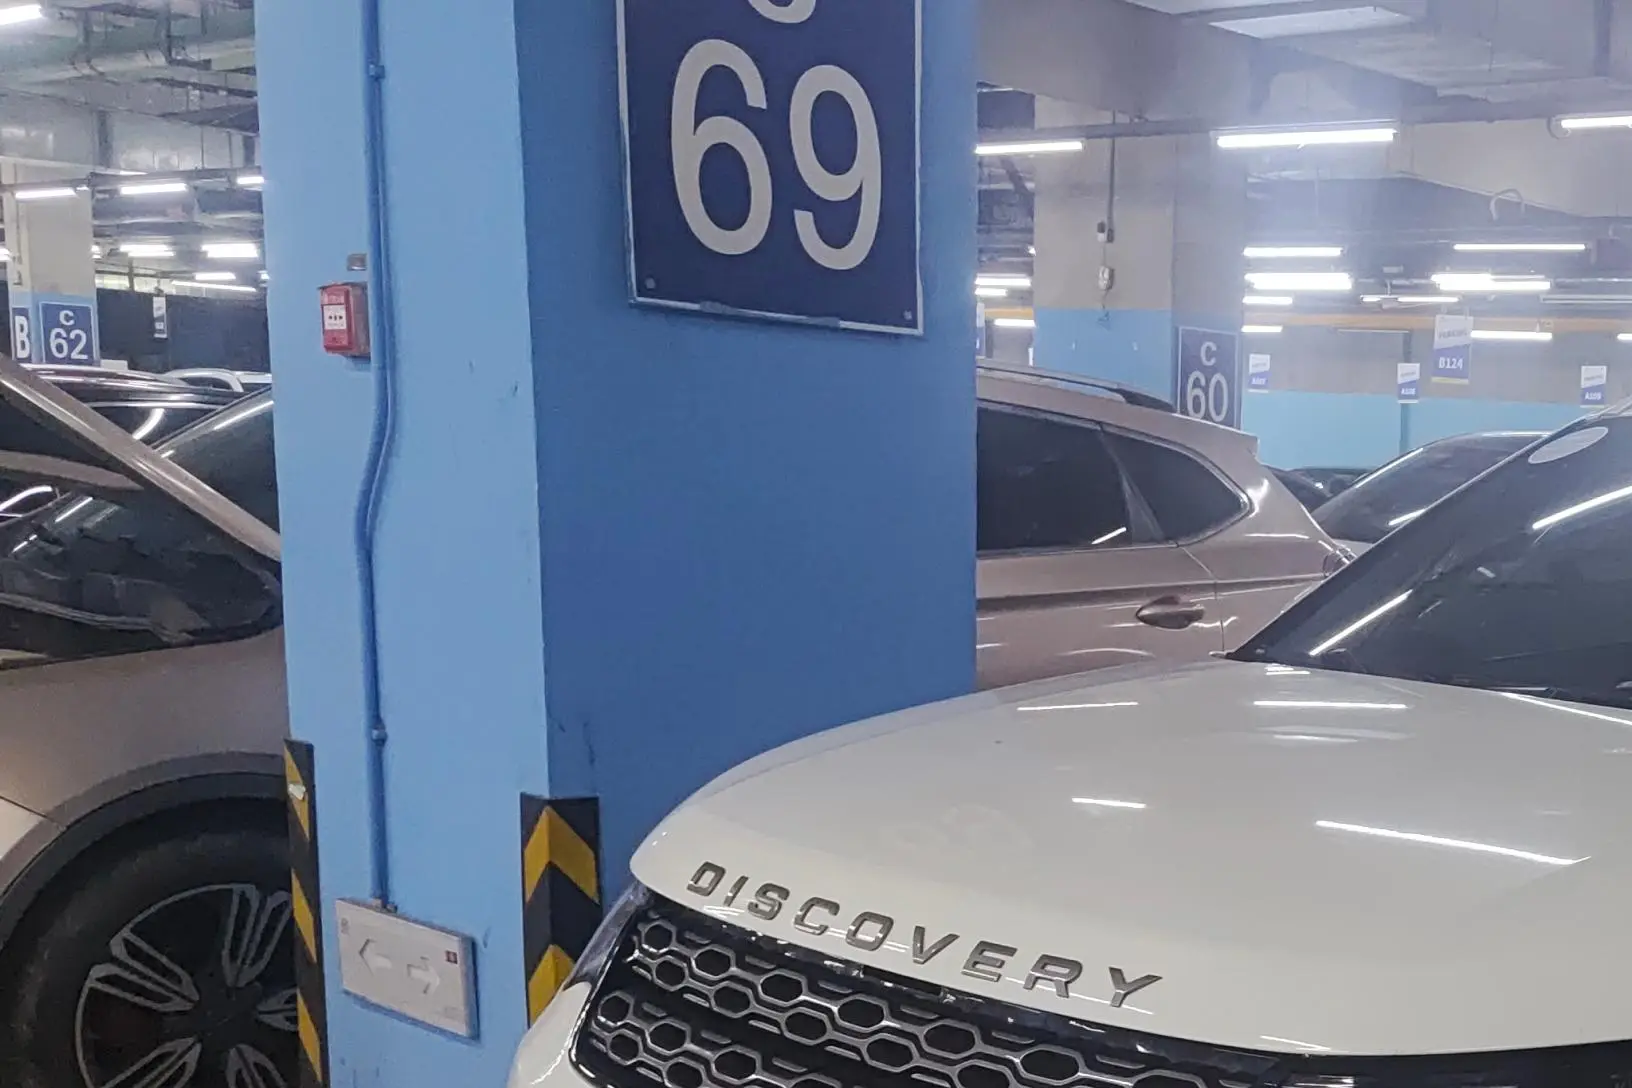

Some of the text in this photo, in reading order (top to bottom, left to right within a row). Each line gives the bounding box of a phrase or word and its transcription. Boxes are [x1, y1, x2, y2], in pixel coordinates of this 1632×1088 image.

[671, 38, 882, 270] 69
[14, 315, 31, 359] B
[59, 310, 75, 326] C
[50, 327, 88, 360] 62
[1200, 341, 1217, 366] C
[1187, 370, 1229, 422] 60
[686, 860, 1163, 1008] DISCOVERY
